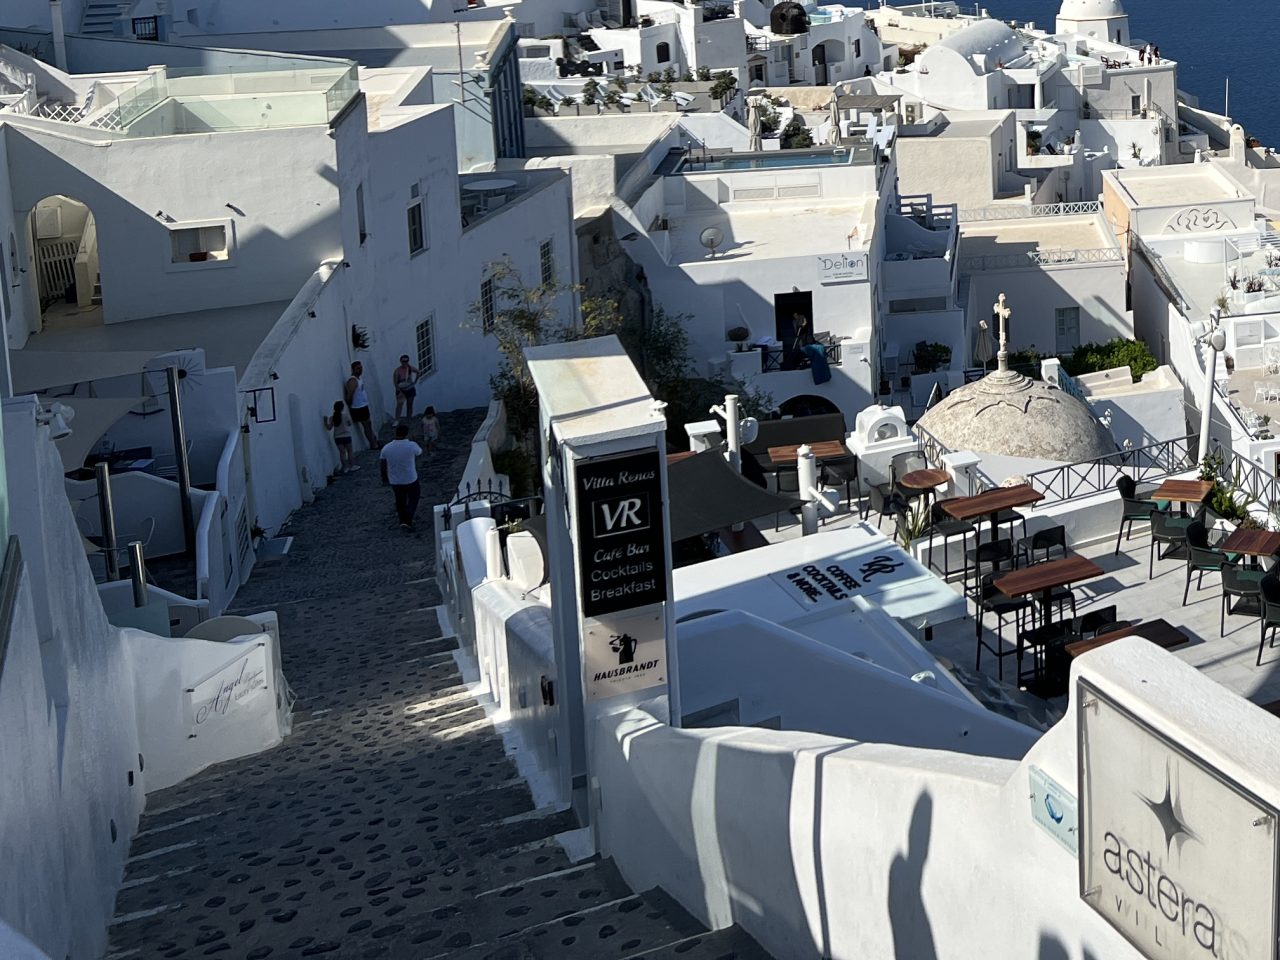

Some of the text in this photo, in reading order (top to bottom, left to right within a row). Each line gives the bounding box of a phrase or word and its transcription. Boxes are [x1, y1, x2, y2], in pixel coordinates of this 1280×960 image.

[821, 257, 864, 271] Delion
[583, 470, 655, 490] Villa Renos
[601, 498, 642, 531] VR
[594, 543, 650, 563] Café Bar
[591, 561, 653, 582] Cocktails
[826, 565, 862, 591] COFFEE
[591, 579, 656, 601] Breakfast
[802, 565, 848, 601] COCKTAILS
[593, 659, 659, 682] HAUSBRANDT
